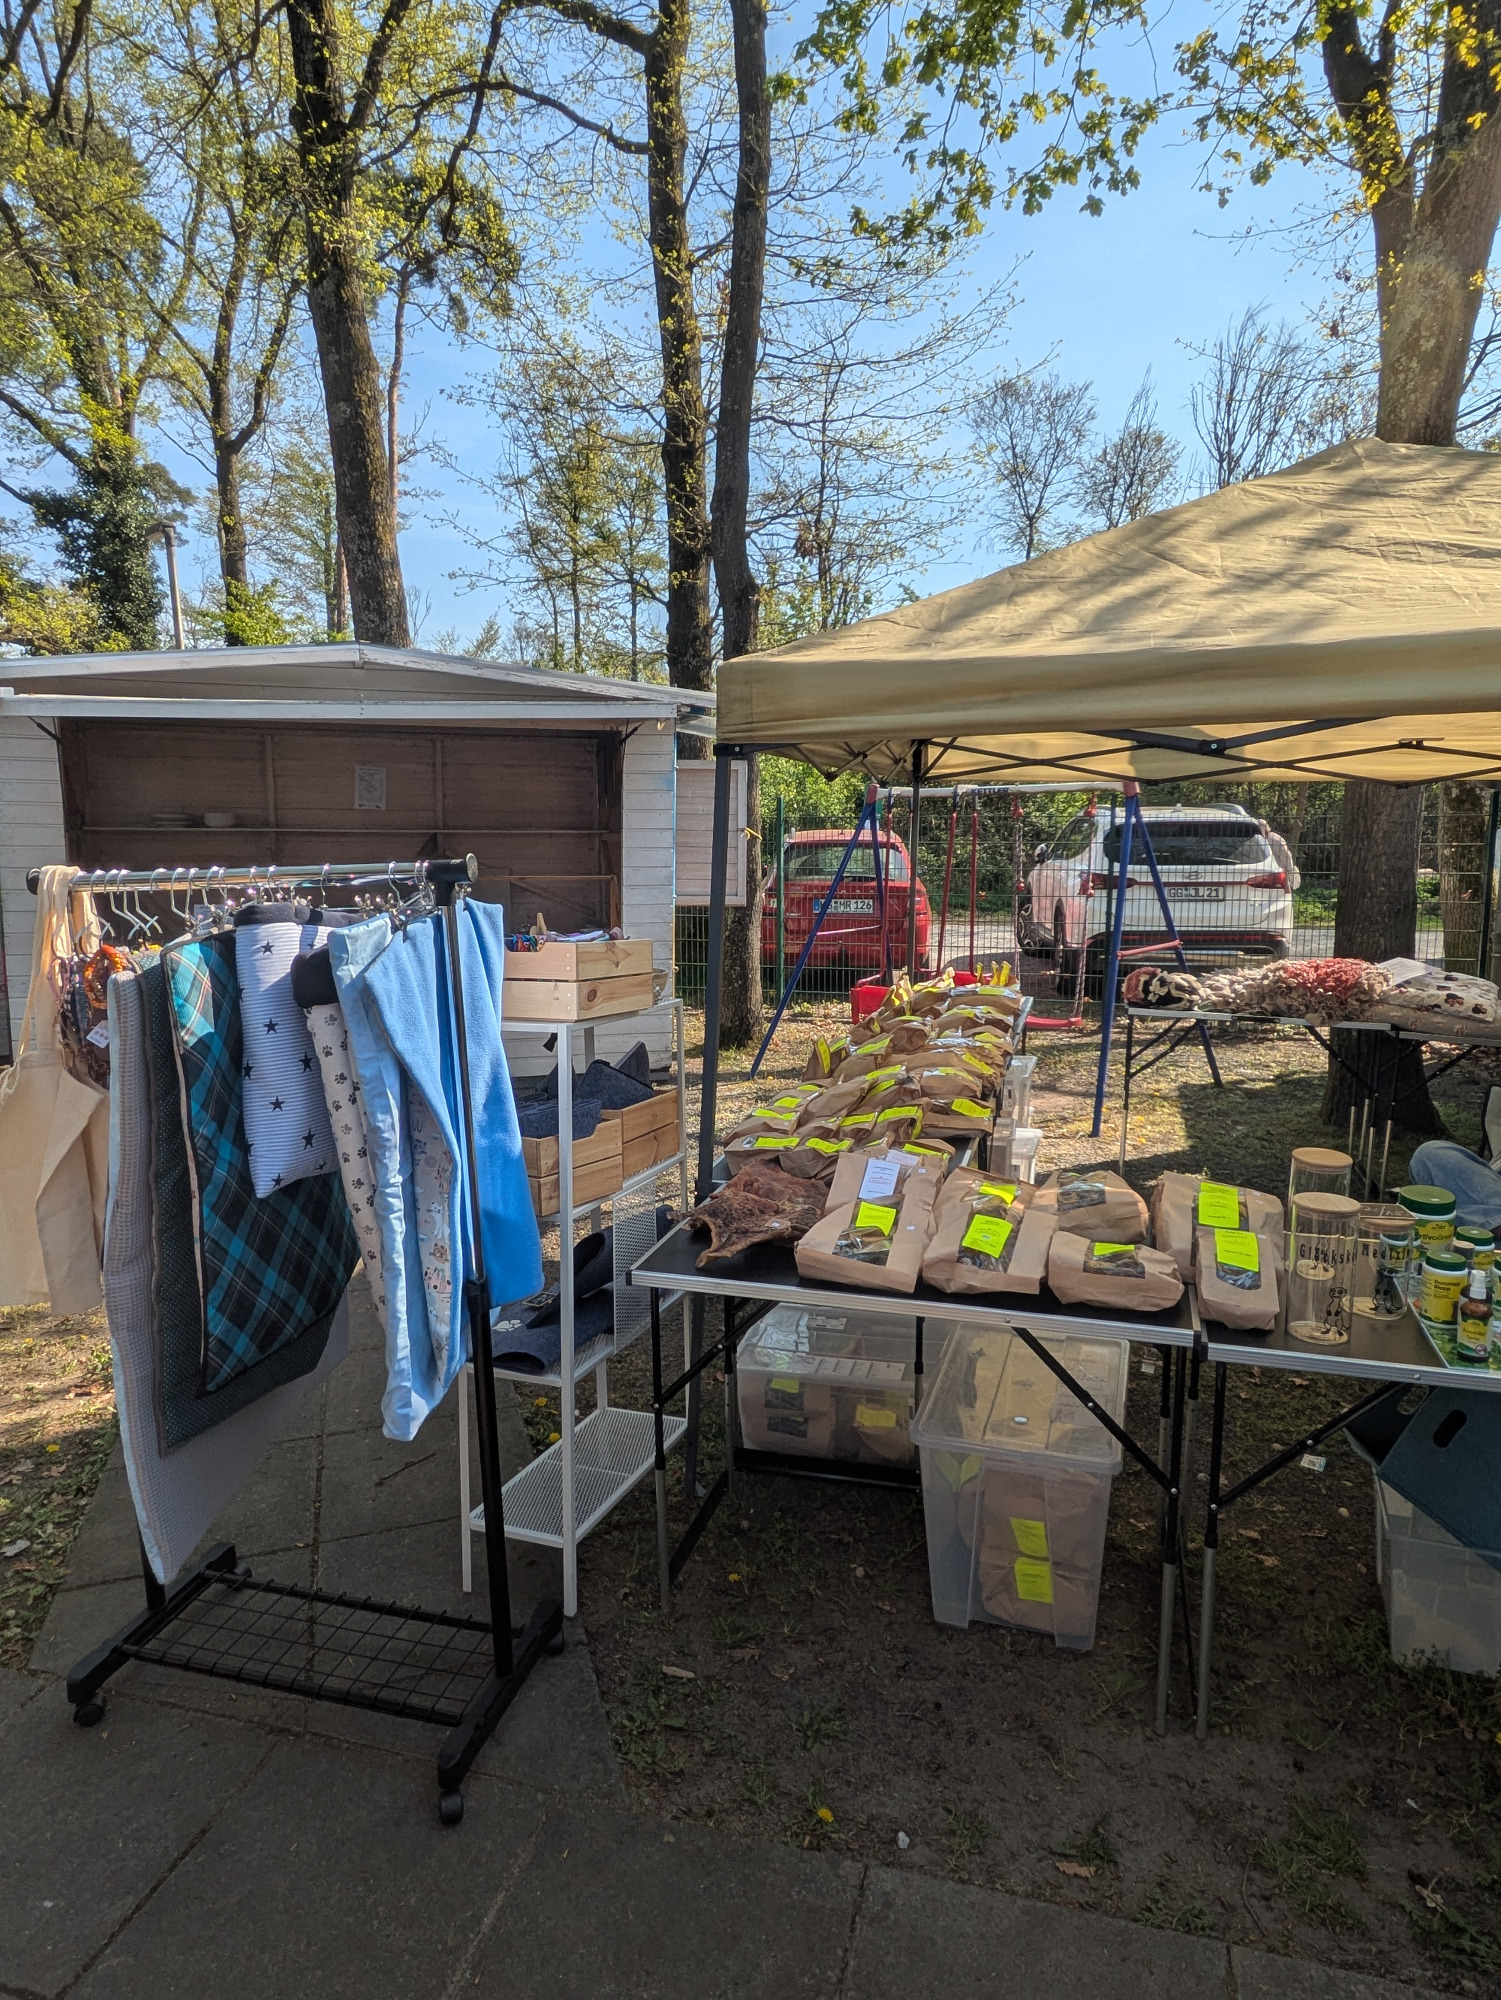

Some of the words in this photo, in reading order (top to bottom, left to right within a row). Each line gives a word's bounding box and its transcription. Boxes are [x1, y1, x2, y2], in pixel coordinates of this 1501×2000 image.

[1169, 887, 1184, 898] GG
[1191, 887, 1205, 898] JL
[1206, 887, 1220, 898] 21
[840, 900, 852, 910] MR
[853, 900, 872, 910] 126
